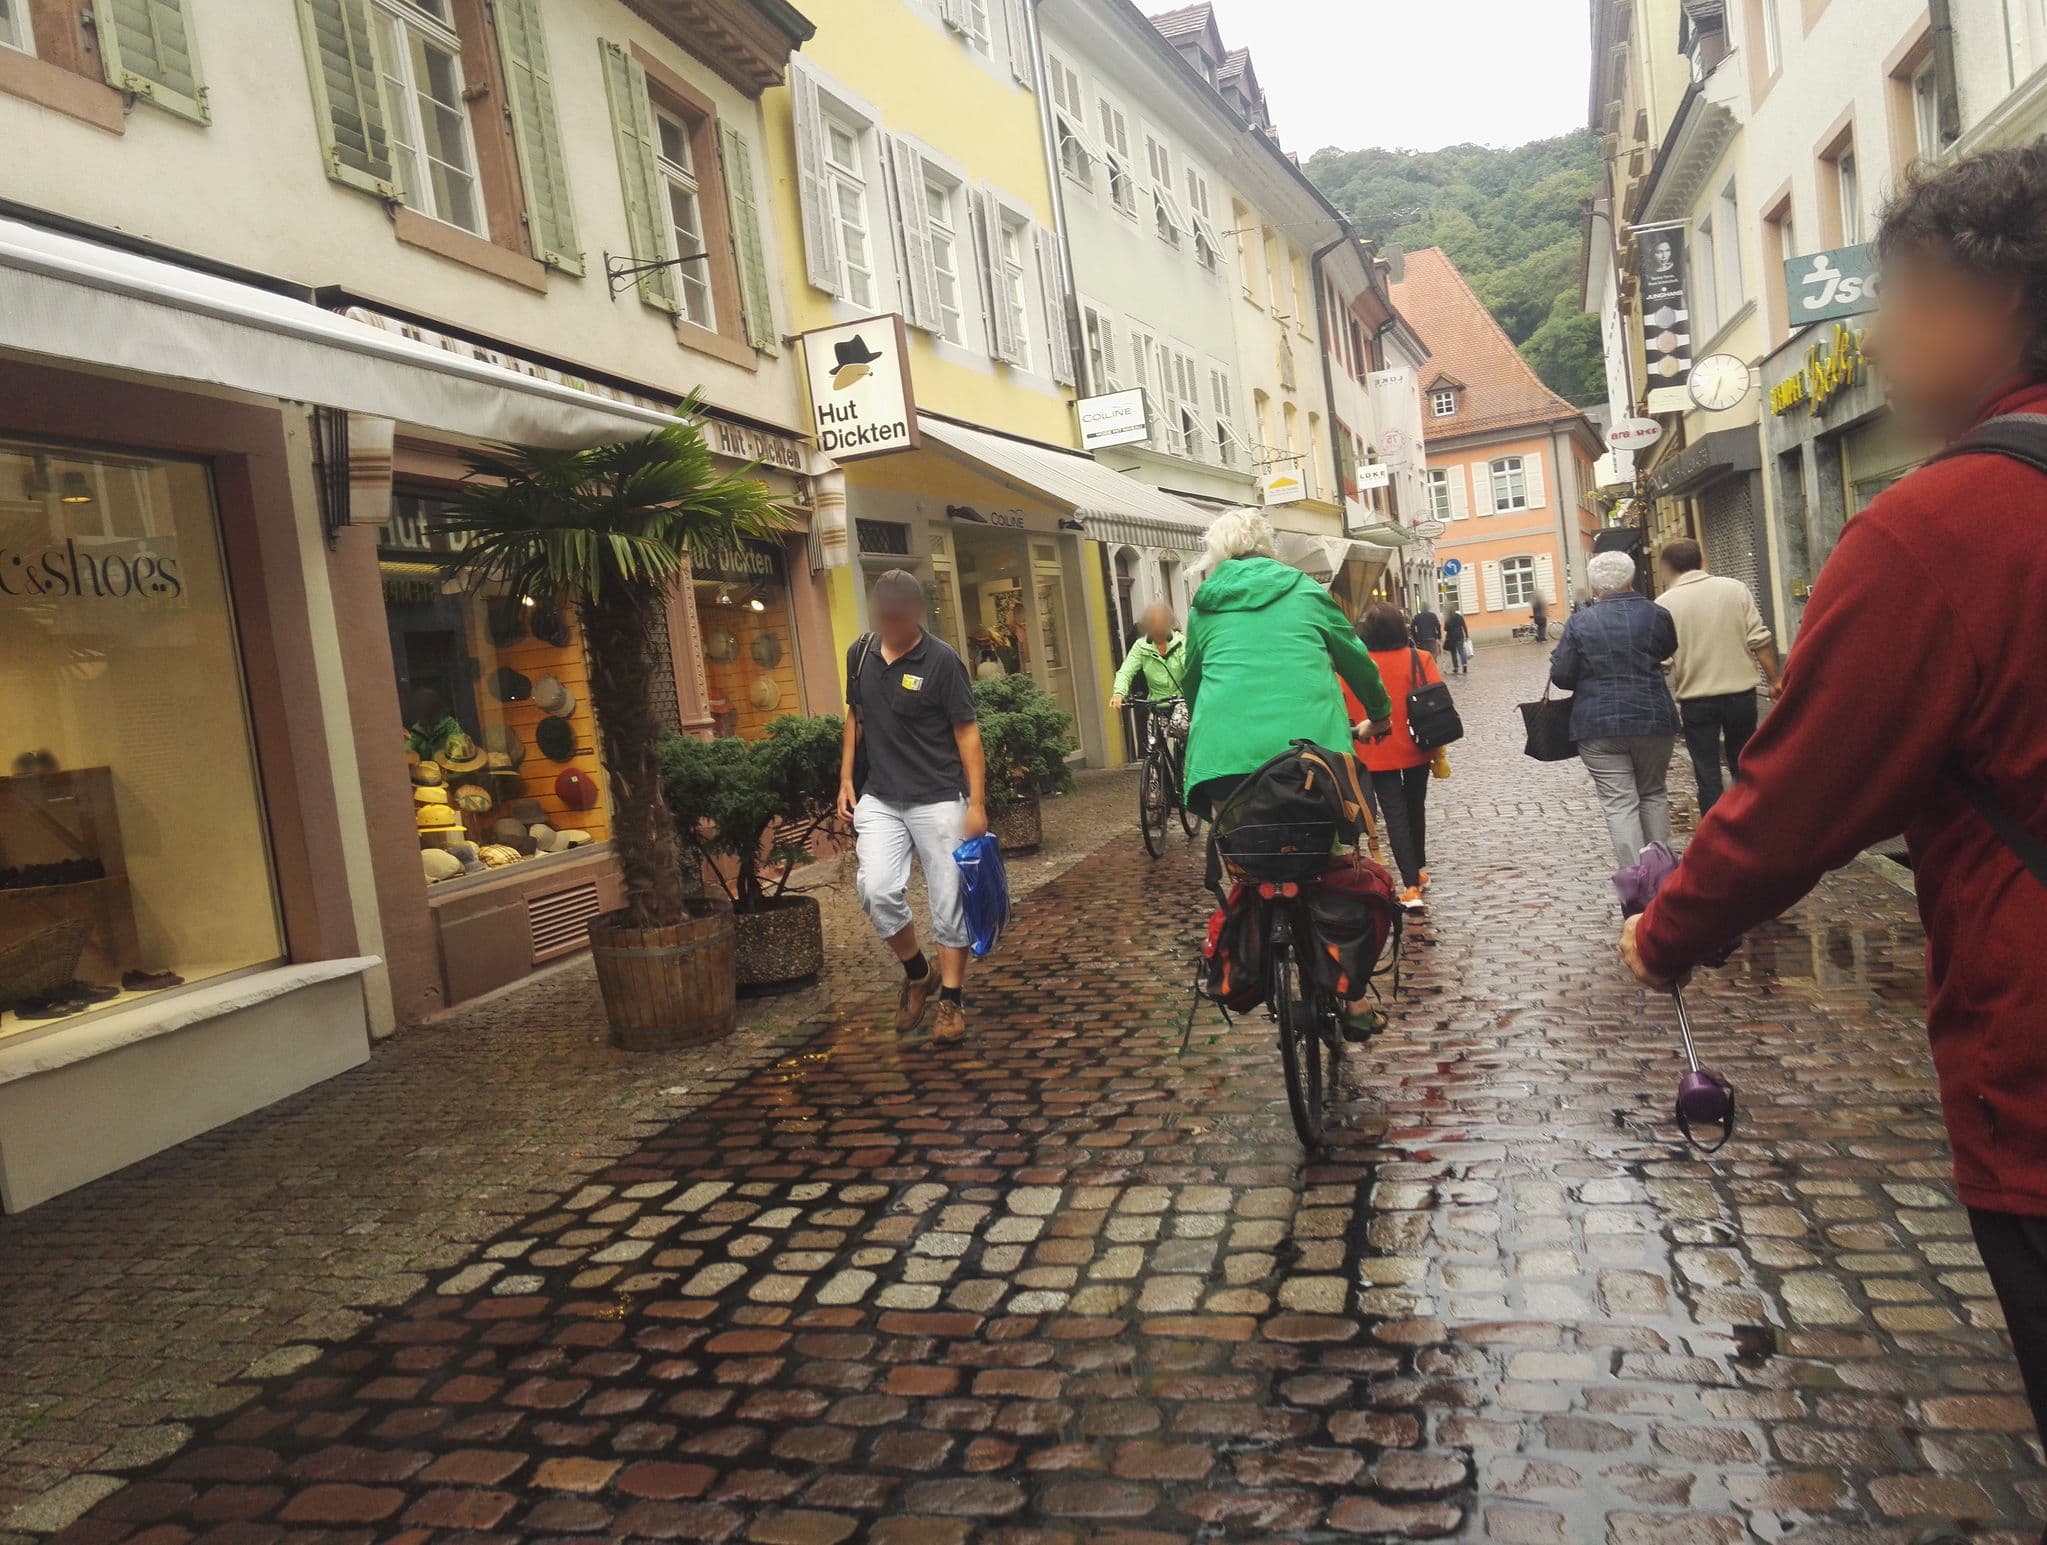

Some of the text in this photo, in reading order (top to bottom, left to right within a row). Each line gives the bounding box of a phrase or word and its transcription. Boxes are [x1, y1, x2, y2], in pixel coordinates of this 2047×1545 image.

[818, 400, 858, 425] Hut
[719, 424, 746, 456] Hut
[753, 433, 801, 469] Dickten
[822, 421, 906, 451] Dickten
